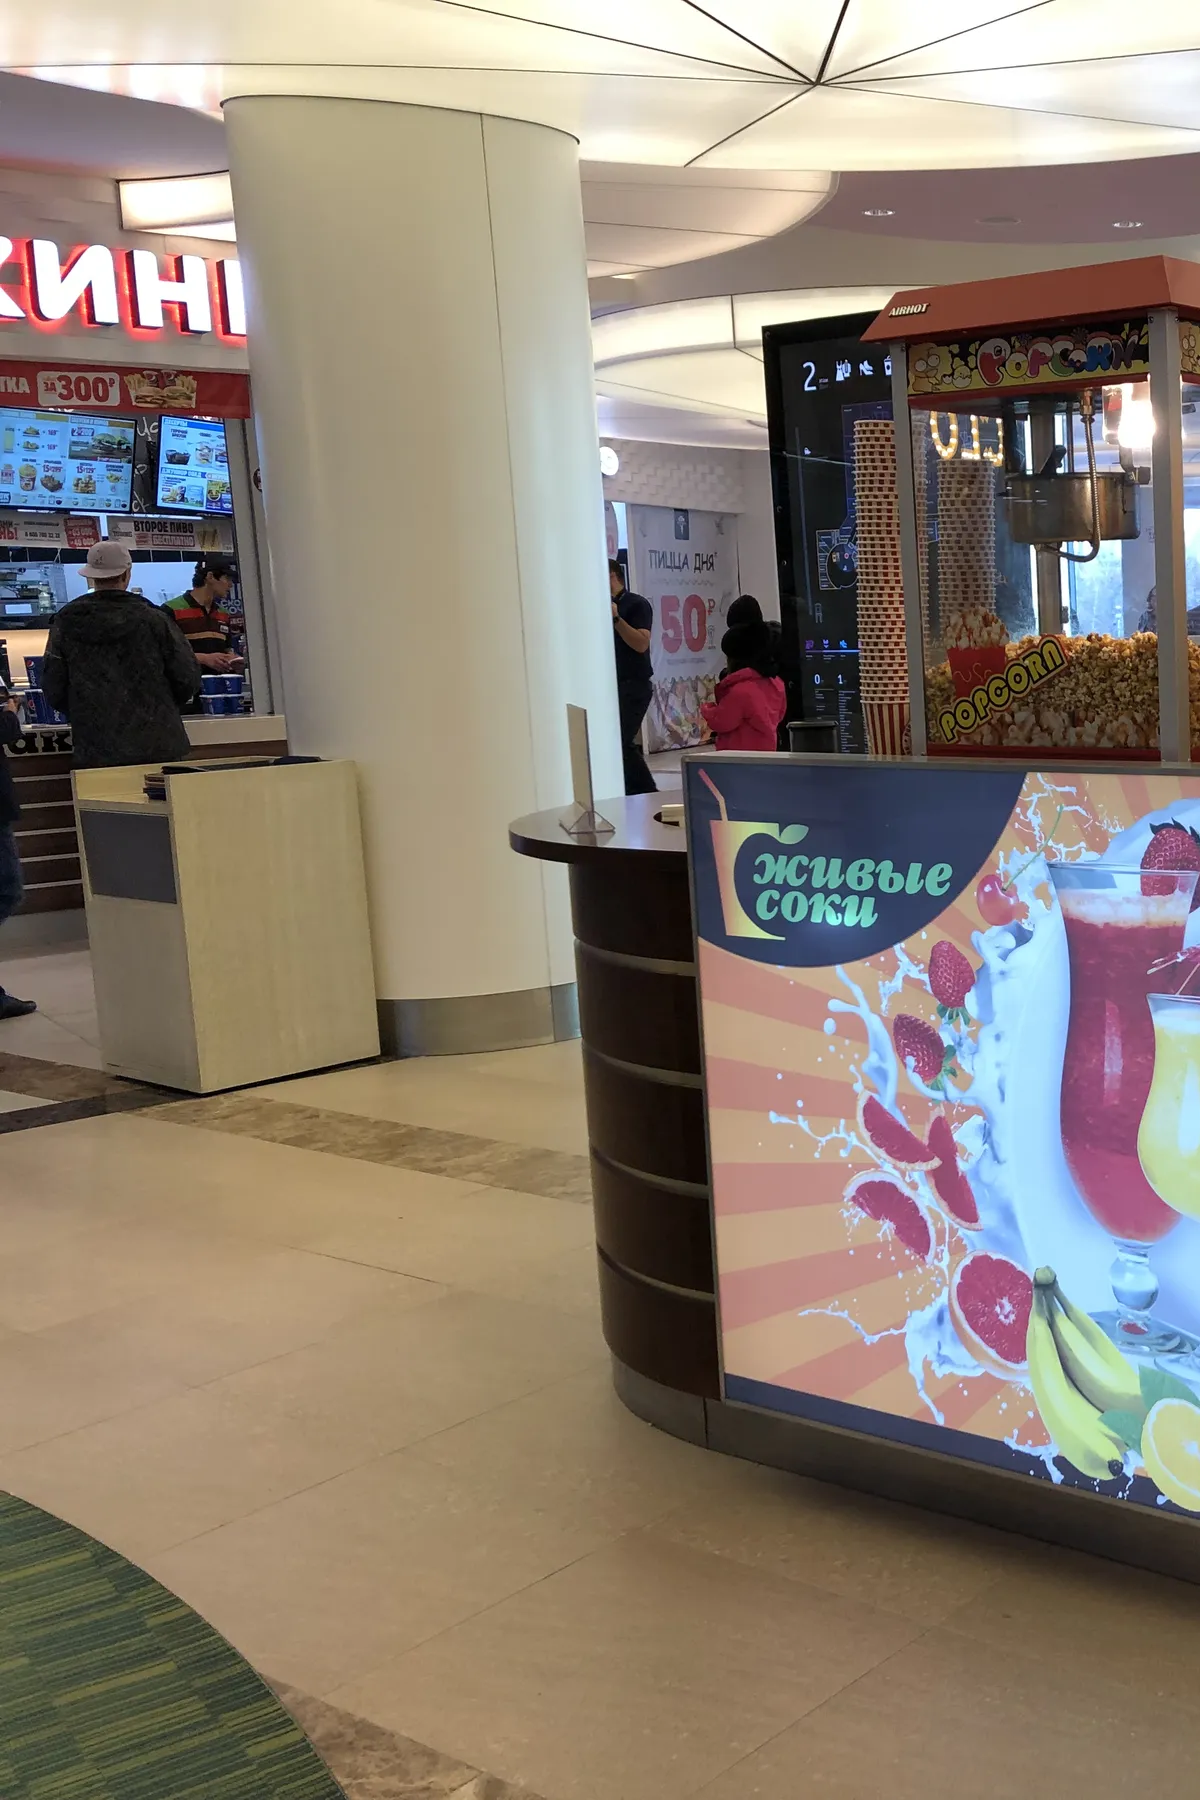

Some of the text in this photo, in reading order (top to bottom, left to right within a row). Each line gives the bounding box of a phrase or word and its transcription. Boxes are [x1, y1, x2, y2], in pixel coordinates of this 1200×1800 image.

[888, 303, 930, 317] AIRHOT
[977, 330, 1139, 386] POPCORN
[803, 361, 817, 391] 2
[134, 521, 194, 533] ВТОРОЕ ПИВО
[648, 550, 690, 572] ПИЦЦА
[939, 639, 1067, 743] POPCORN
